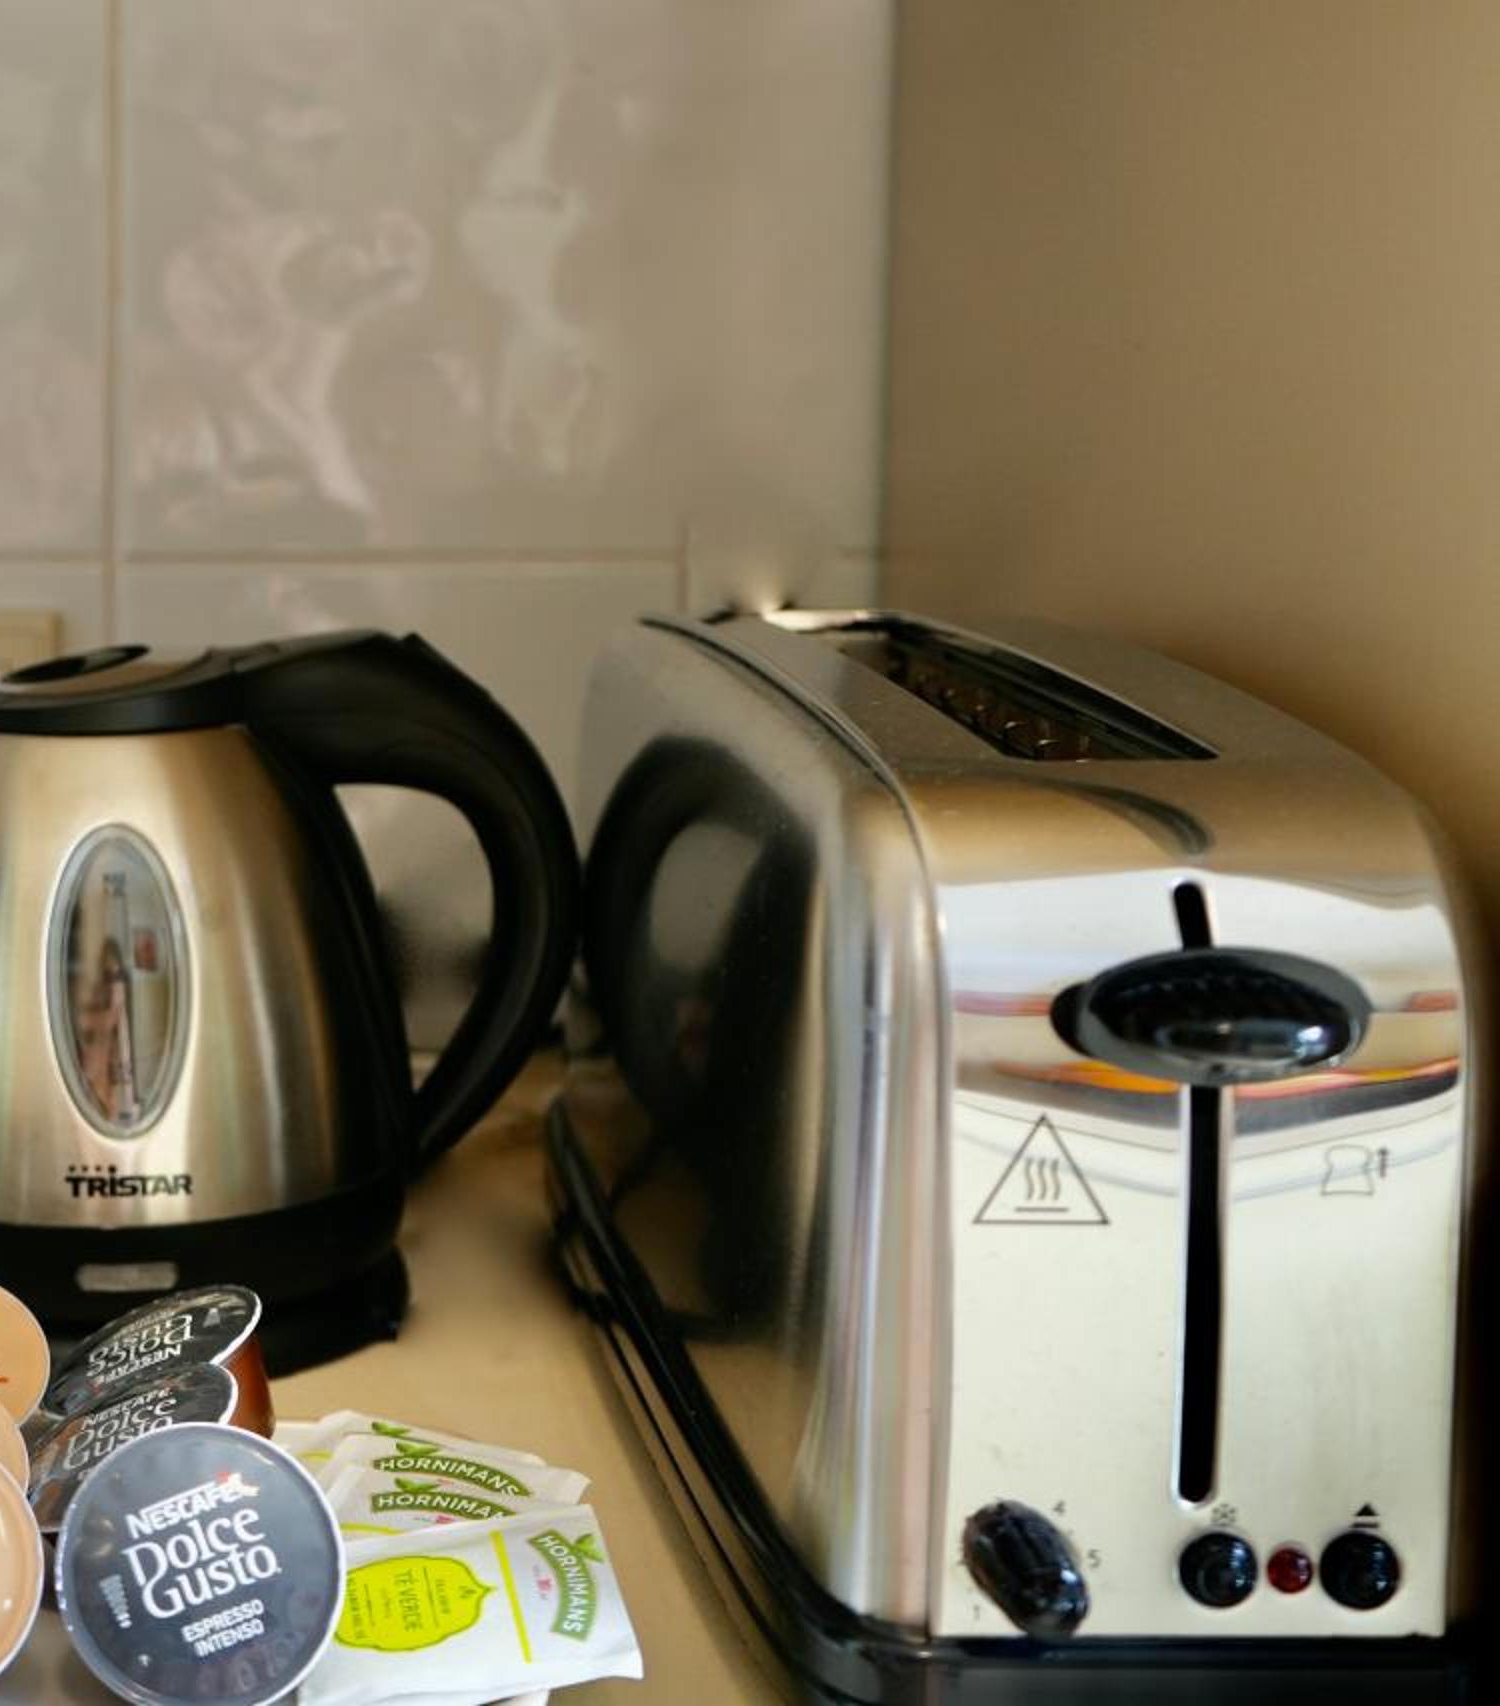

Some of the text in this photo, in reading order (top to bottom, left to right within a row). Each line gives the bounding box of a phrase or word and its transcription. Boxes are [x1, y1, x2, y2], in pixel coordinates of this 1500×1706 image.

[68, 1397, 177, 1452] Dolce
[379, 1456, 521, 1497] HORNIMANS
[1053, 1500, 1066, 1515] 4
[122, 1507, 266, 1587] Dolce
[1087, 1549, 1101, 1569] 5
[142, 1545, 280, 1619] Gusto
[542, 1535, 589, 1634] HORNIMANS
[182, 1599, 265, 1643] ESPRESSO
[194, 1619, 265, 1658] INTENSO
